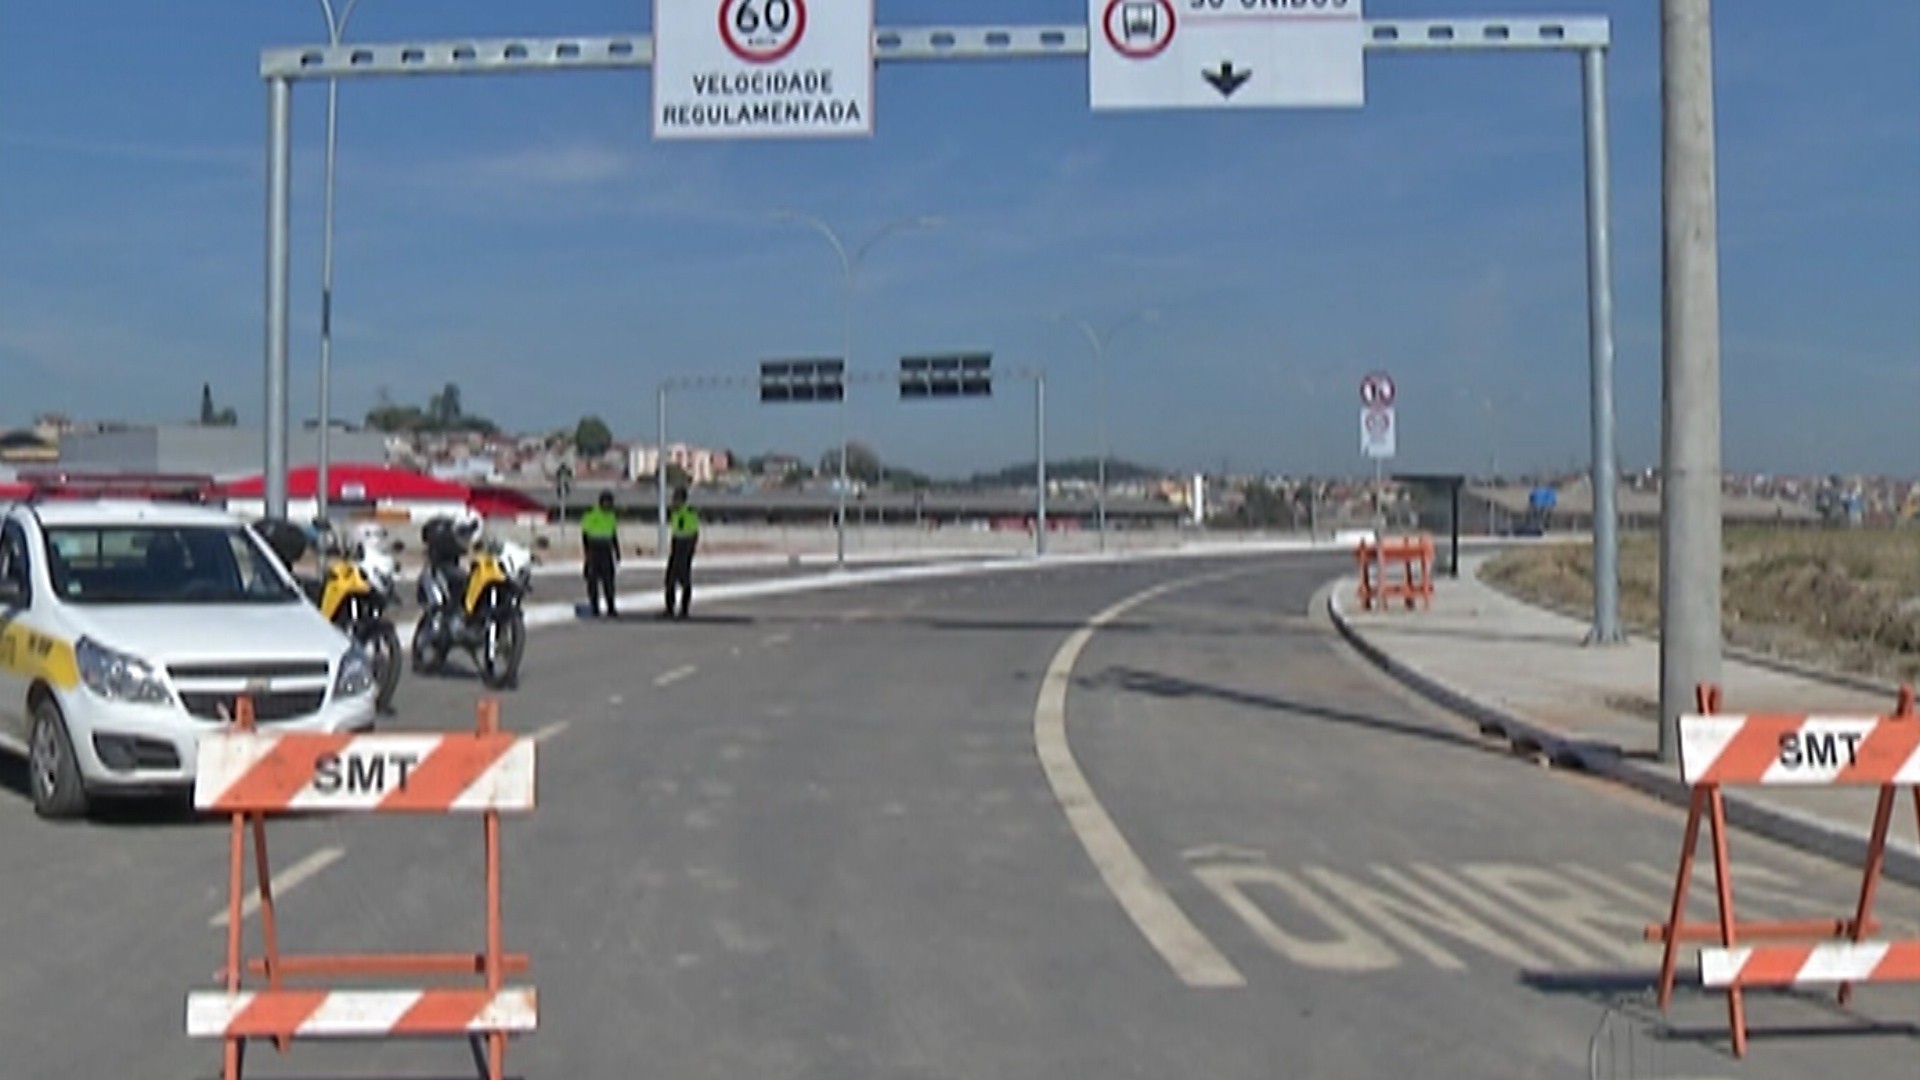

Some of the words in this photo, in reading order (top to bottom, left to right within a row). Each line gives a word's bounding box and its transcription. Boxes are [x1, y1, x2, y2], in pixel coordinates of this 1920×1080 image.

[736, 0, 789, 33] 60
[692, 69, 833, 96] VELOCIDADE
[662, 100, 861, 126] REGULAMENTADA
[1778, 730, 1862, 770] SMT
[313, 752, 419, 794] SMT
